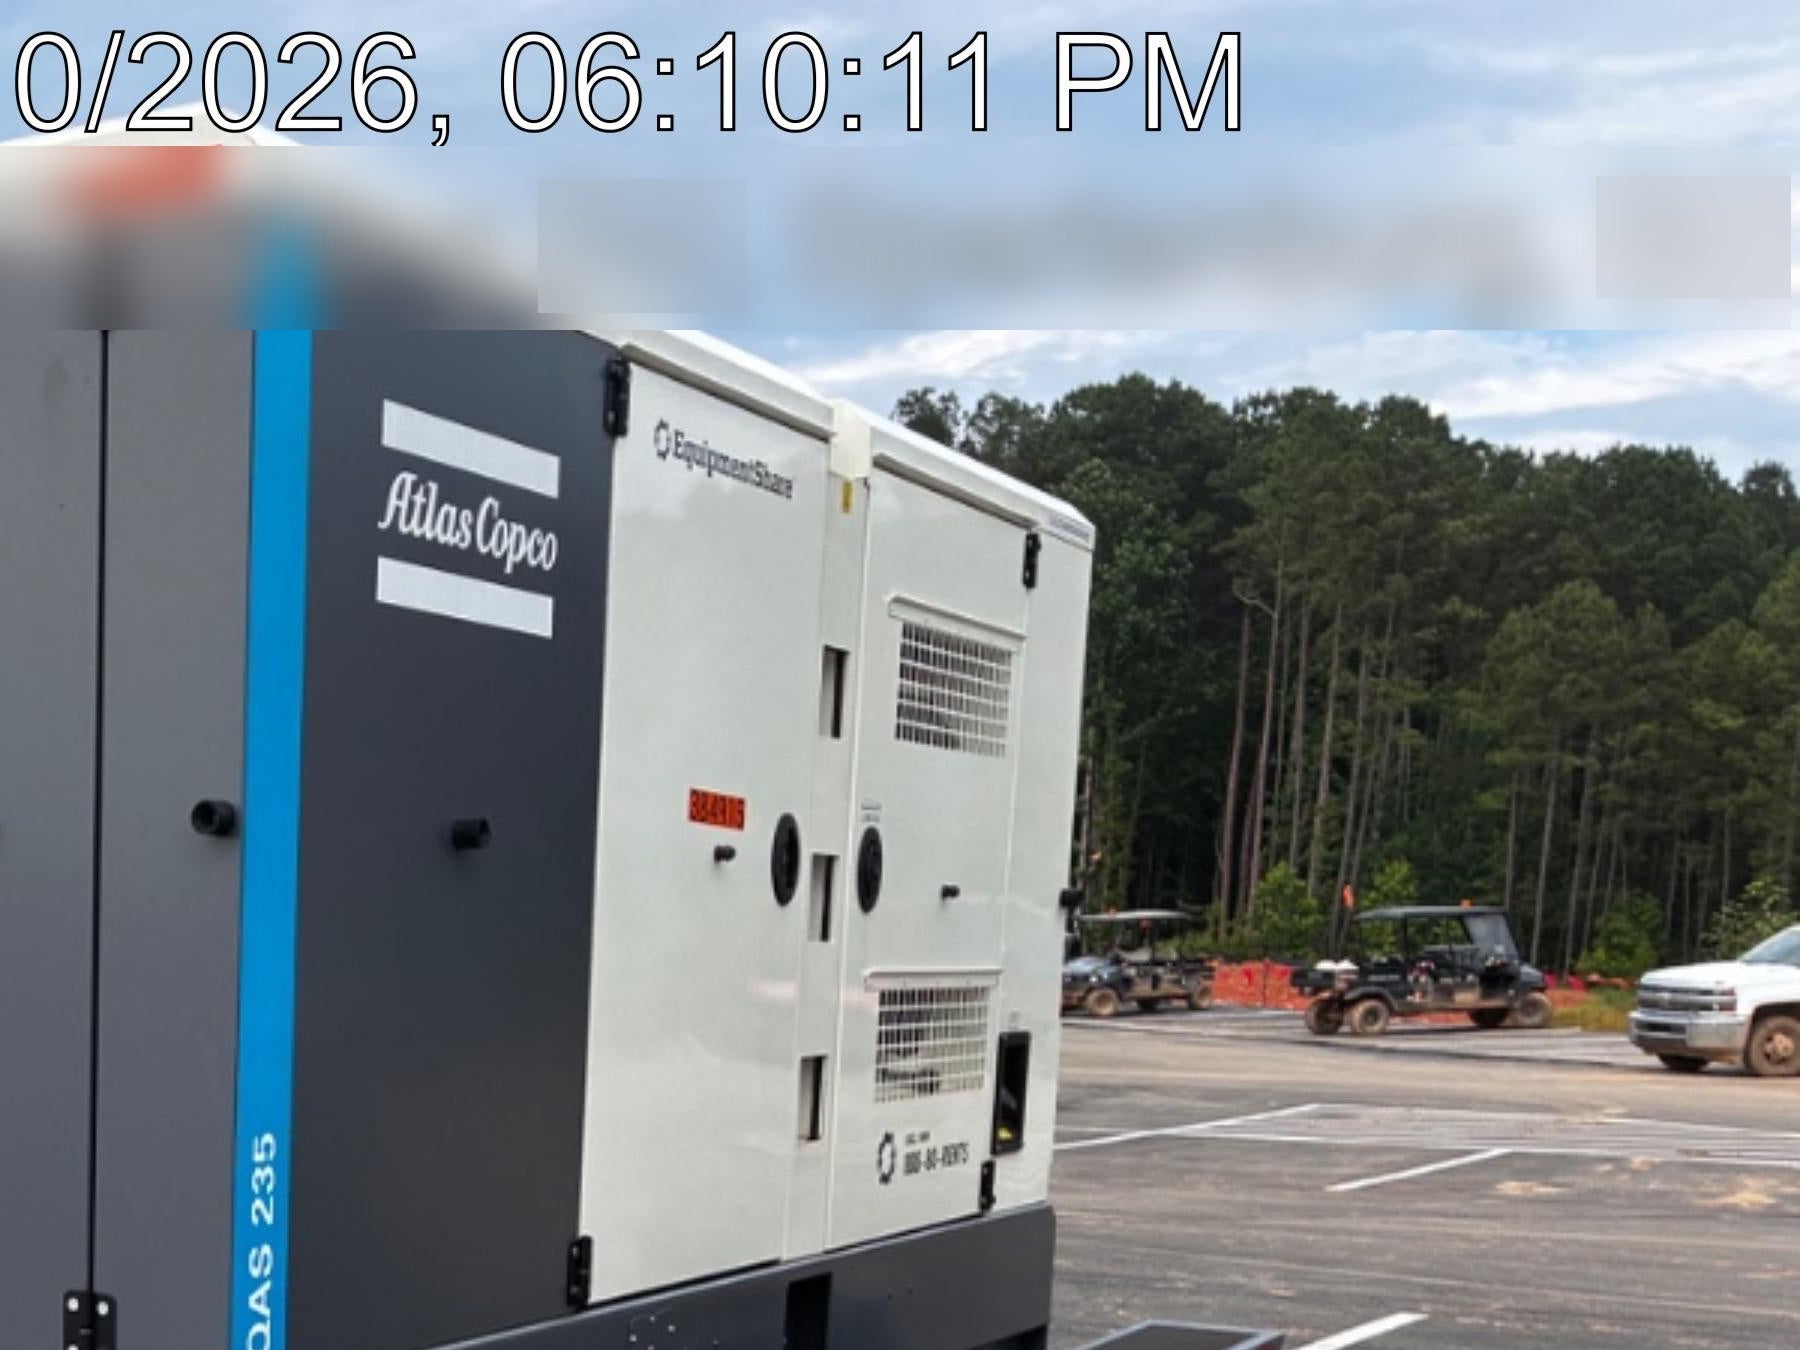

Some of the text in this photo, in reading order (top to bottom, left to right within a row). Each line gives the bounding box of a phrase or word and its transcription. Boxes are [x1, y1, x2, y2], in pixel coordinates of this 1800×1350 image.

[673, 428, 793, 500] EquipmentShare
[377, 470, 559, 574] Atlas Copco
[251, 1132, 277, 1226] 235
